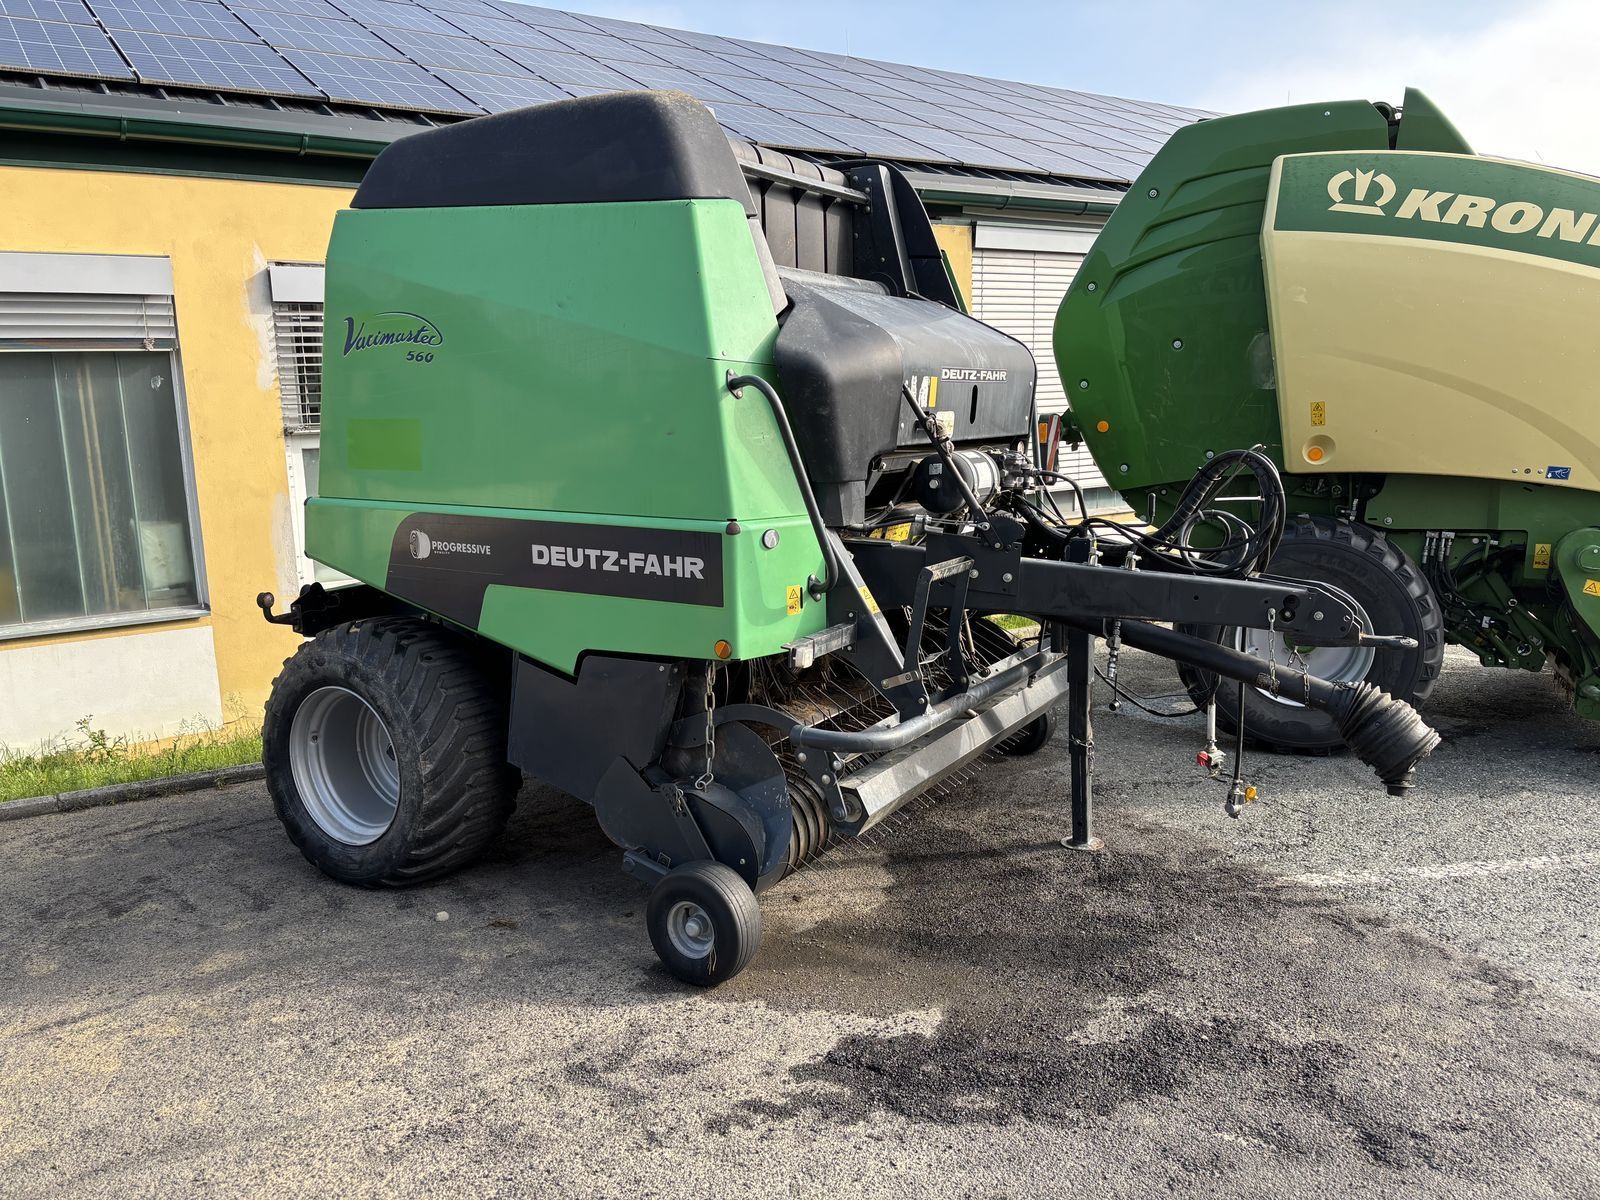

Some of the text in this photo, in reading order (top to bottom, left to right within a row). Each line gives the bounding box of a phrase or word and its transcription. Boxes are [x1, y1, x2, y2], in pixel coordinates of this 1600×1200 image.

[406, 350, 434, 363] 560
[941, 368, 1007, 381] DEUTZ-FAHR
[432, 541, 491, 555] PROGRESSIVE
[531, 544, 705, 579] DEUTZ-FAHR
